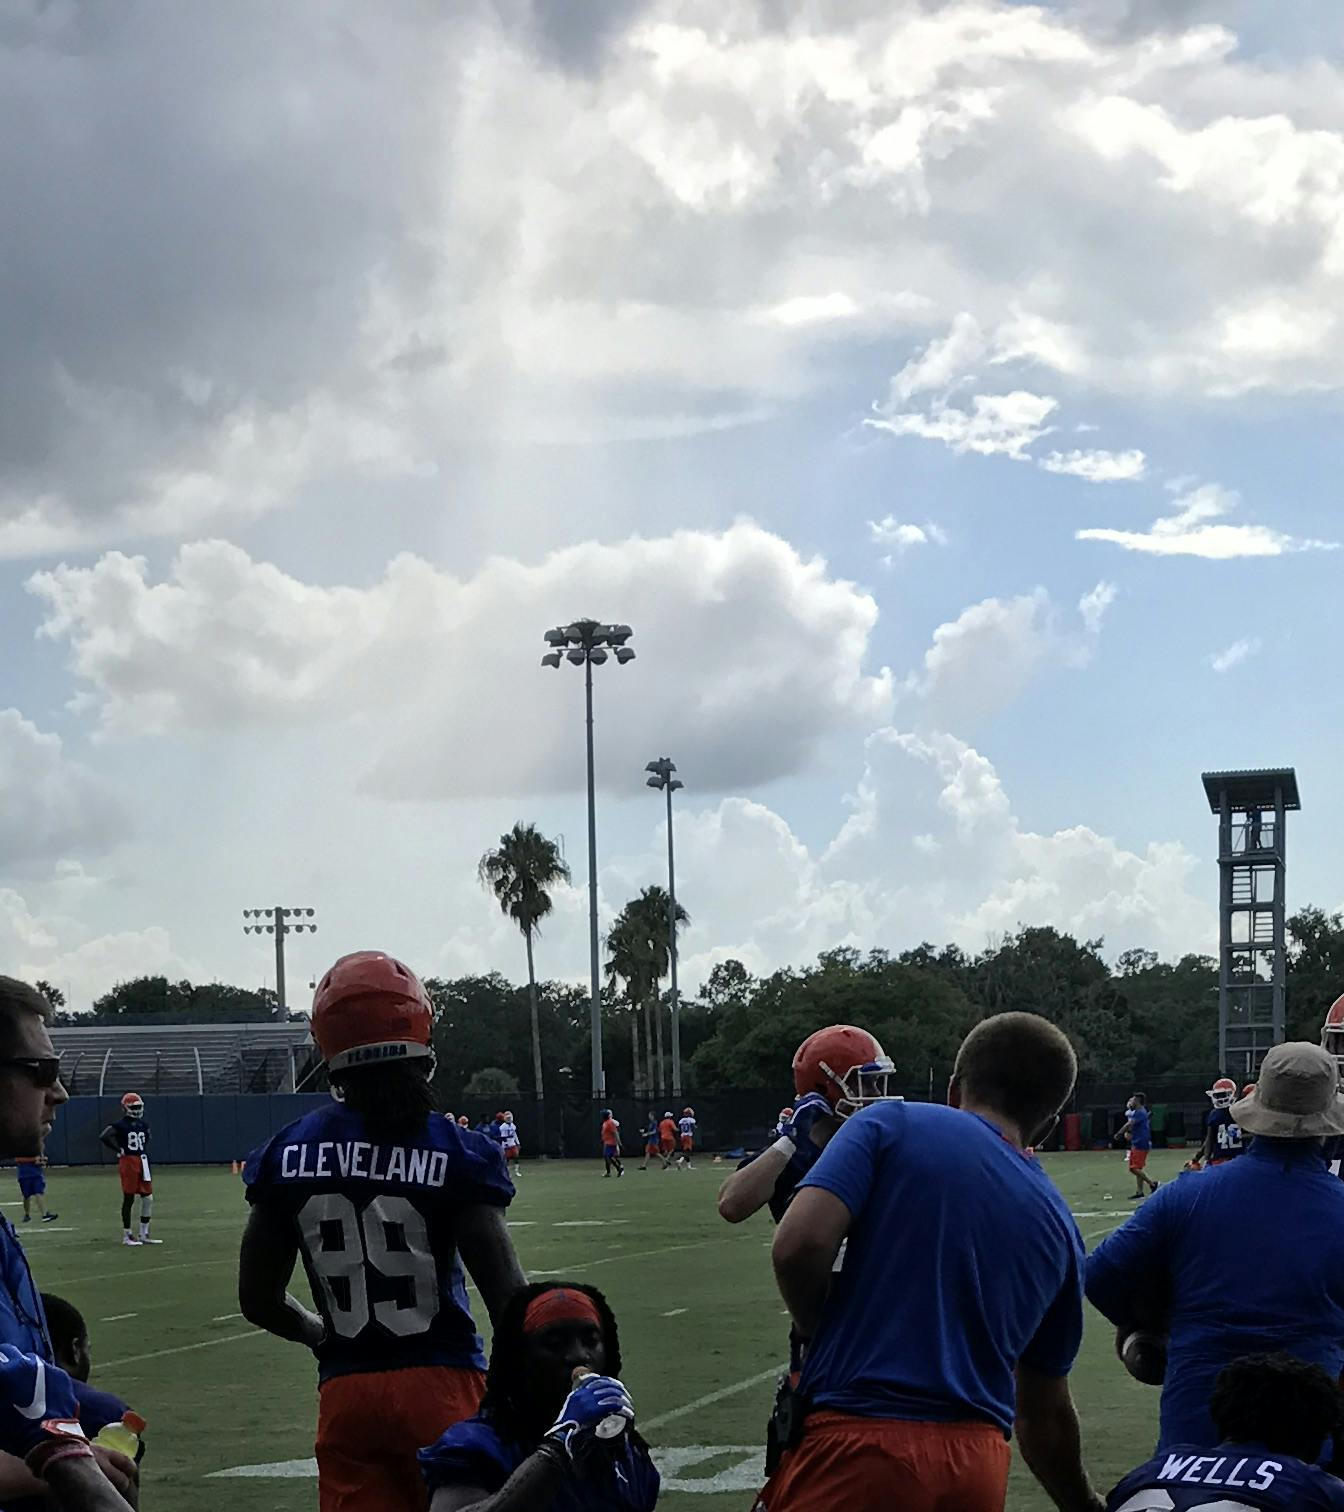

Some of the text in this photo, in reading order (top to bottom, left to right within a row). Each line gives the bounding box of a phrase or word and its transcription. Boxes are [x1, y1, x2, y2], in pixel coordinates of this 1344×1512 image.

[281, 1141, 449, 1188] CLEVELAND
[297, 1193, 440, 1340] 89
[1157, 1453, 1283, 1491] WELLS
